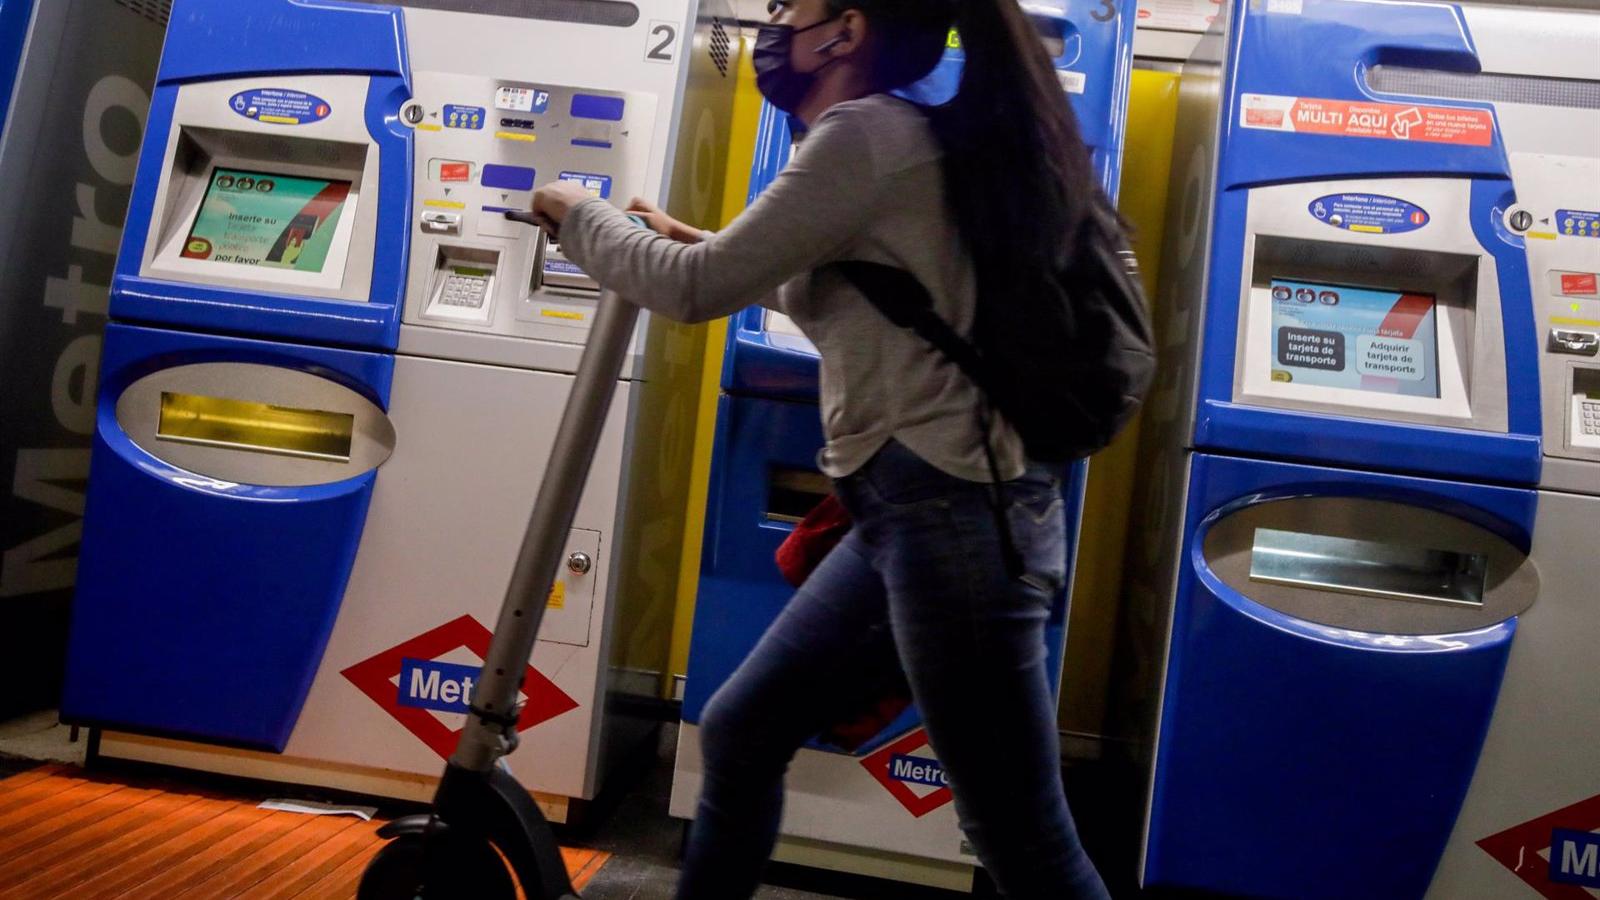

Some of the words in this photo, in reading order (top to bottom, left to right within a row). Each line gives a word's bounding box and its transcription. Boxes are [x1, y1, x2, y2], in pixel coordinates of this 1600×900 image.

[647, 24, 675, 60] 2
[1297, 110, 1343, 125] MULTI
[229, 213, 262, 223] Inserte
[234, 255, 260, 265] favor
[2, 74, 151, 599] Metro
[1287, 332, 1321, 344] Inserte
[1323, 336, 1336, 345] su
[1288, 343, 1320, 355] tarjeta
[1321, 344, 1334, 355] de
[1370, 341, 1411, 354] Adquirir
[1285, 352, 1337, 366] transporte
[1367, 351, 1399, 364] tarjeta
[1400, 355, 1413, 363] de
[1364, 361, 1416, 375] transporte
[409, 667, 474, 706] Met
